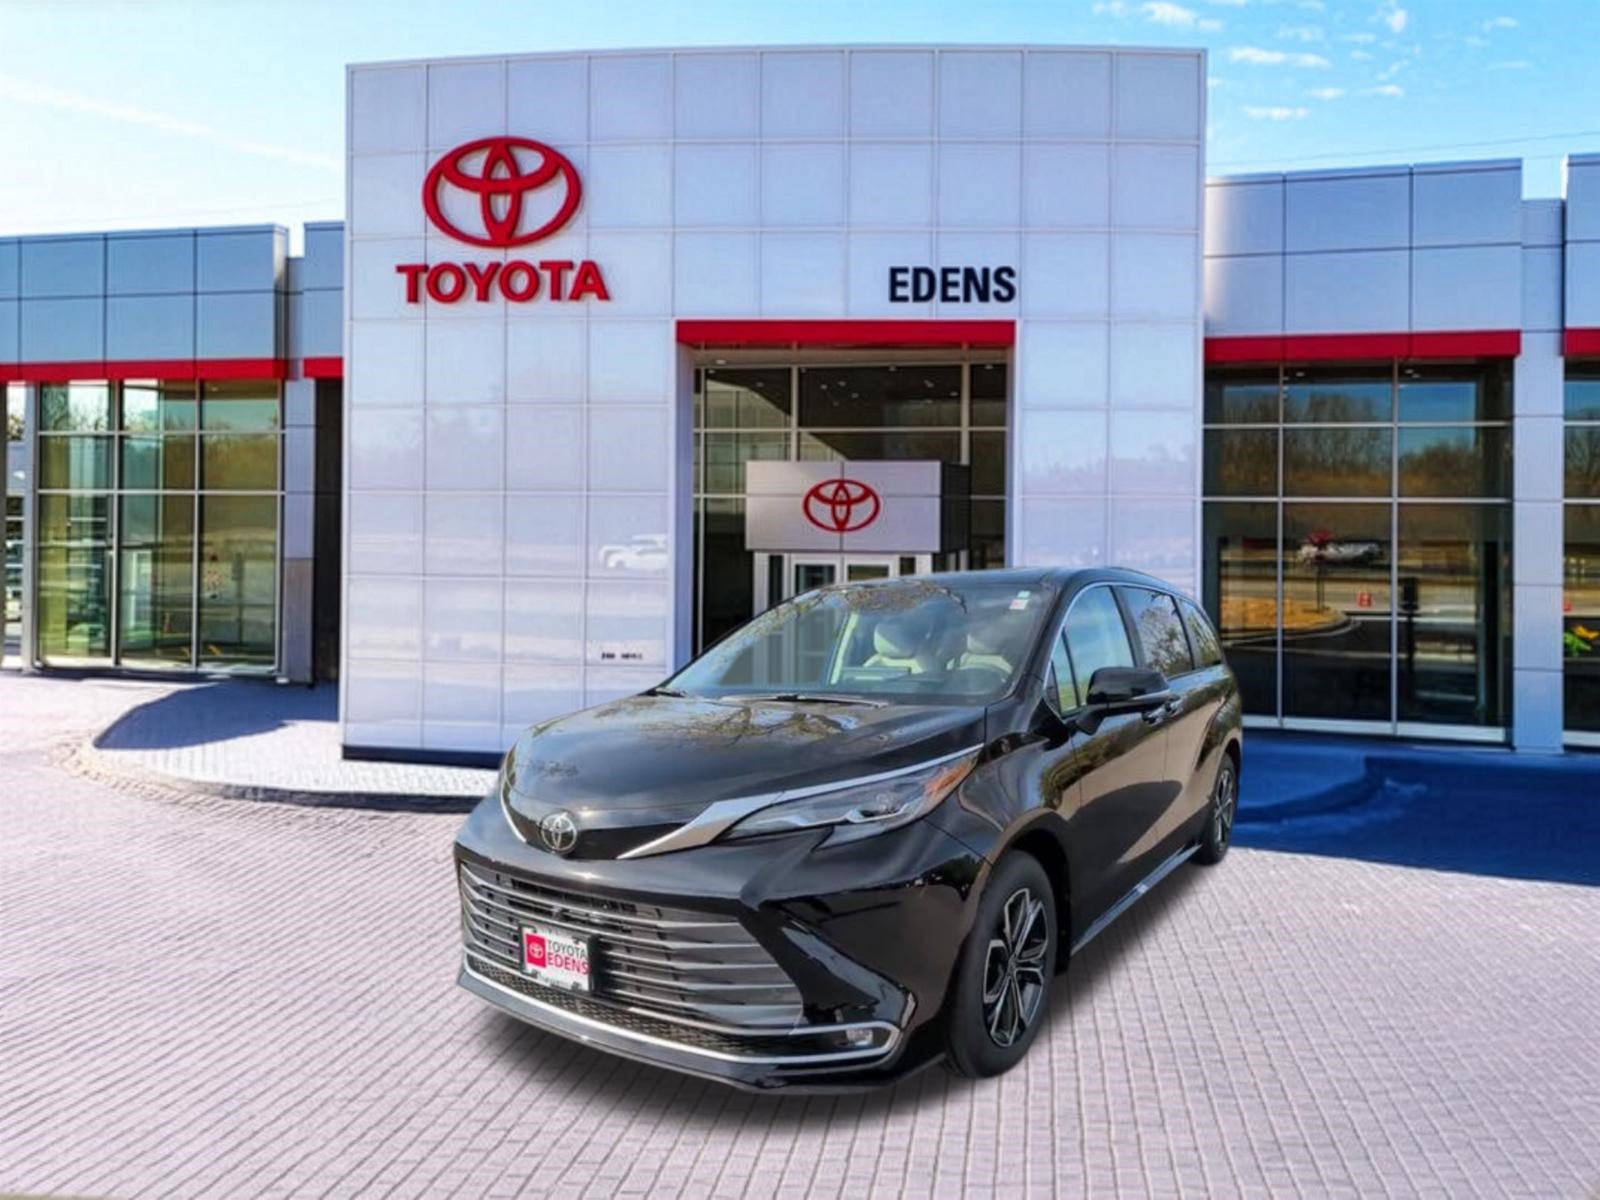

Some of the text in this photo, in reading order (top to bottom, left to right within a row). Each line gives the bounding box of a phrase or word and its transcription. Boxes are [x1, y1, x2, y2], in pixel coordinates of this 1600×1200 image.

[396, 260, 611, 304] TOYOTA
[889, 266, 1017, 303] EDENS
[547, 939, 588, 960] TOYOTA
[547, 951, 590, 976] EDENS
